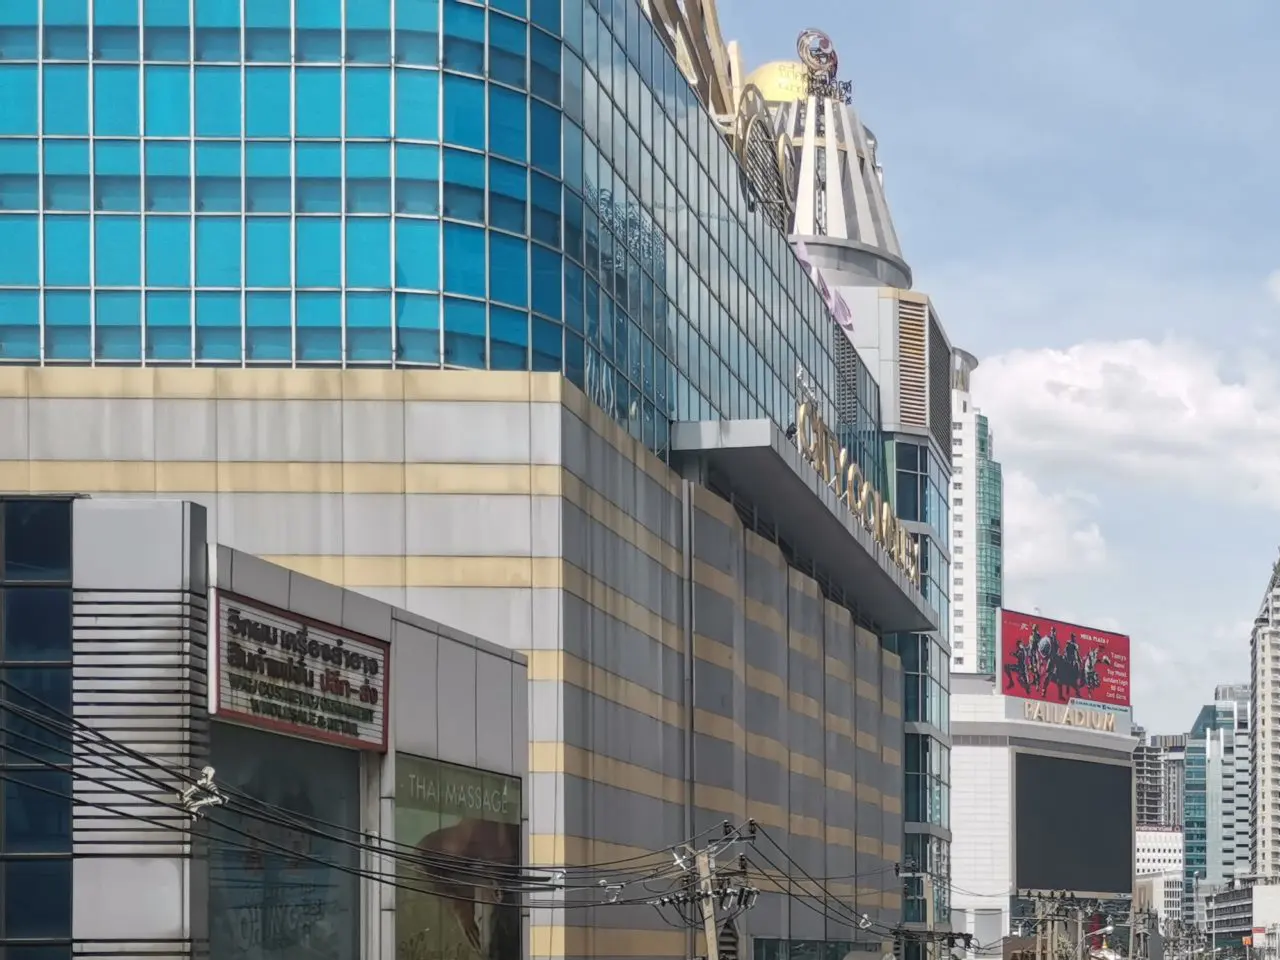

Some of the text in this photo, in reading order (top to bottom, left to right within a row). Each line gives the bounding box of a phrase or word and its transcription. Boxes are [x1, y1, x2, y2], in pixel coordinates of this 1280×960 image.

[1023, 700, 1117, 732] PALLADIUM
[409, 774, 509, 814] THAI MASSAGE
